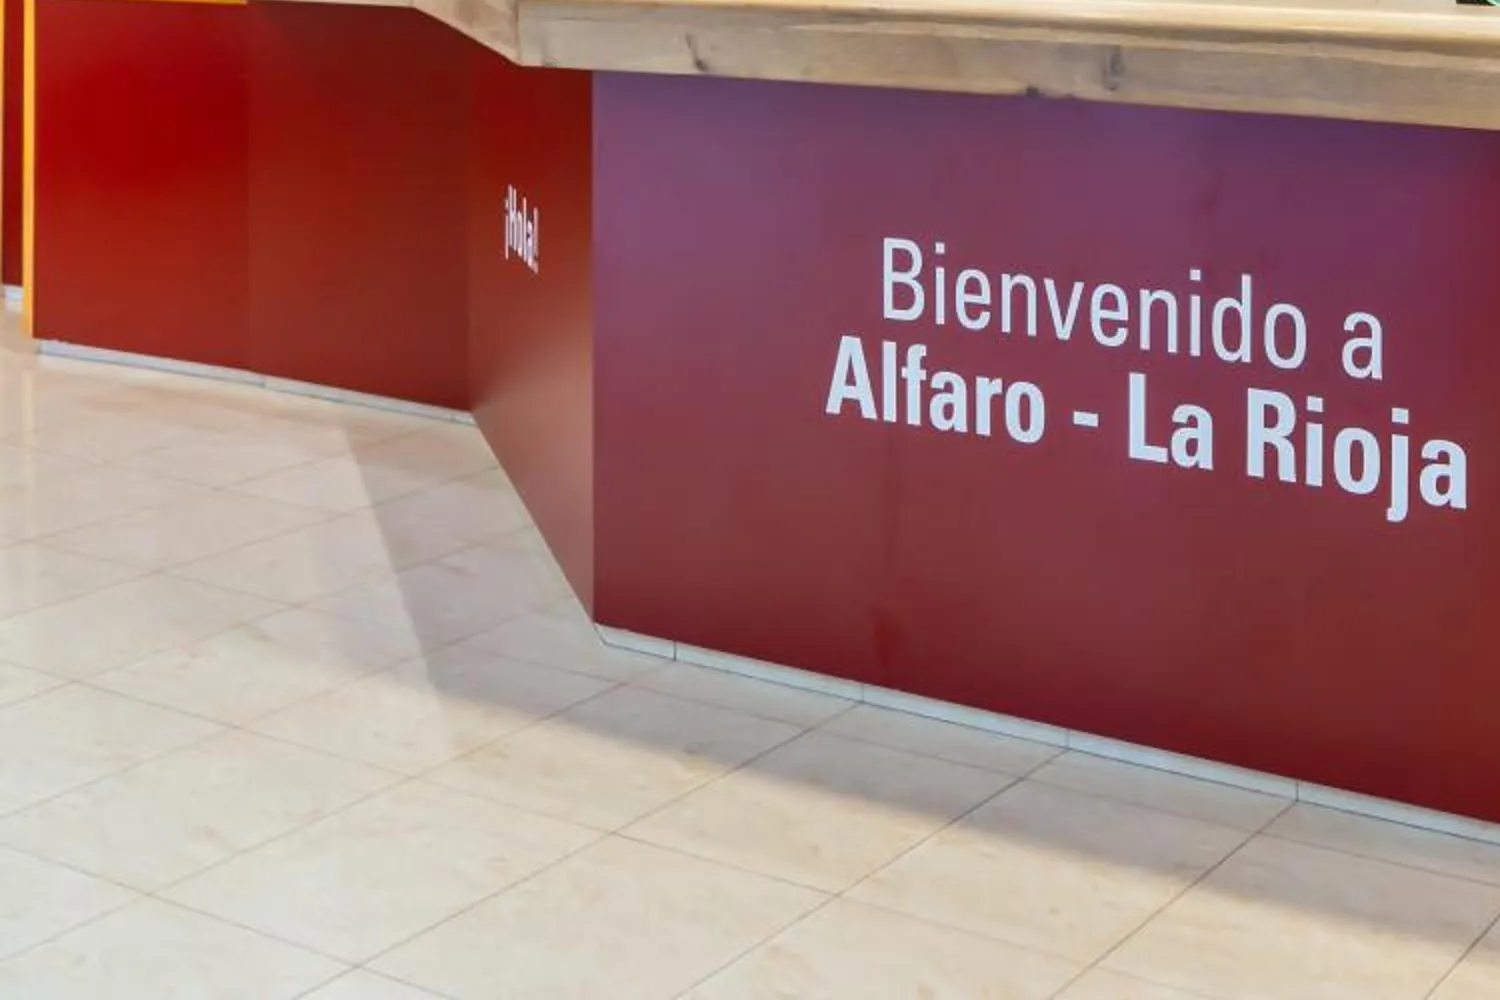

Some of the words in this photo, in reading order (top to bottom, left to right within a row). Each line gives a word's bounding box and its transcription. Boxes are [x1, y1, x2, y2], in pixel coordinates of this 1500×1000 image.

[504, 183, 539, 275] ¡Hola!
[882, 237, 1308, 370] Bienvenido
[1341, 311, 1384, 381] a
[825, 334, 1046, 445] Alfaro
[1072, 410, 1099, 428] -
[1127, 372, 1214, 471] La
[1246, 387, 1468, 523] Rioja
